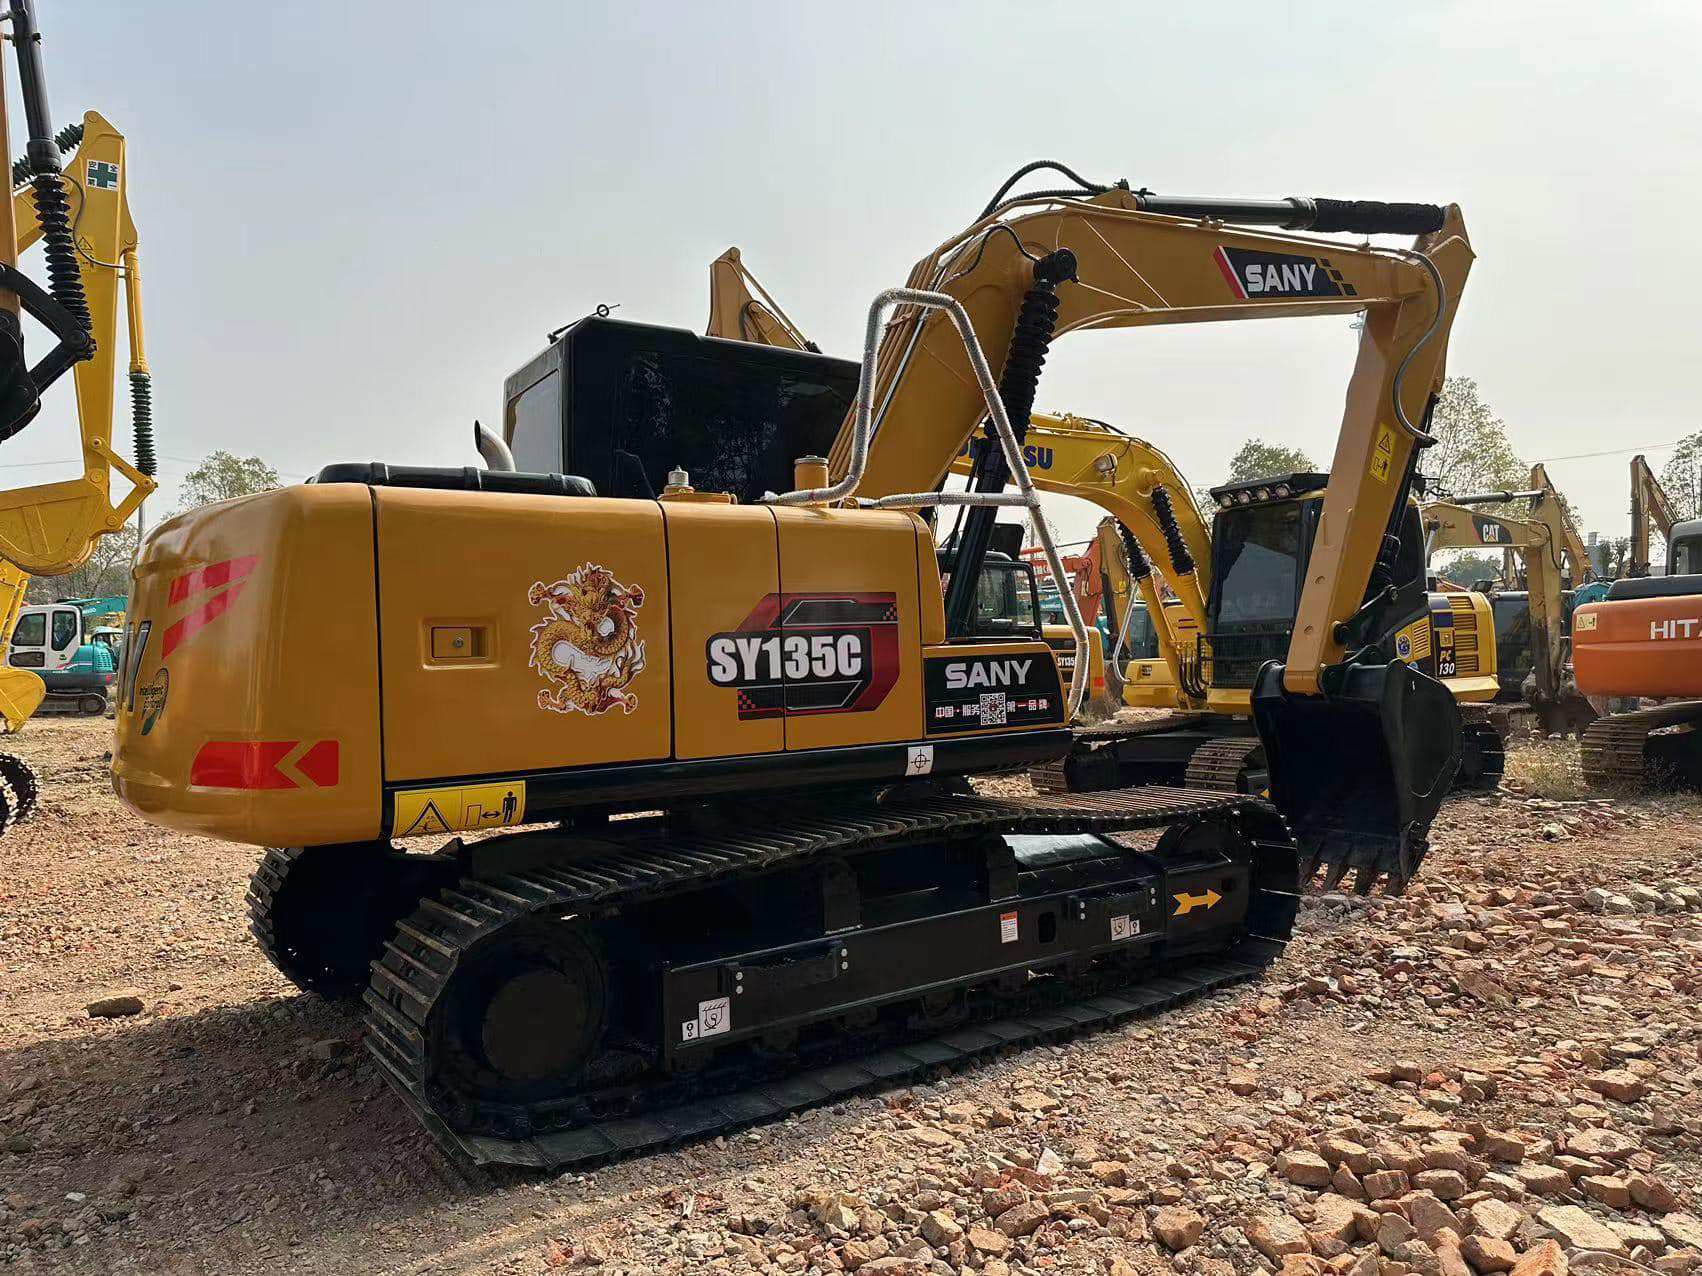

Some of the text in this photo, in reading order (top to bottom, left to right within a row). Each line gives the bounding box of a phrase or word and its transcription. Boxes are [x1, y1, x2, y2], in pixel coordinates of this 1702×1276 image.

[1245, 264, 1316, 292] SANY
[1482, 524, 1500, 543] CAT
[1650, 618, 1702, 641] HIT
[709, 634, 863, 683] SY135C
[1057, 656, 1077, 667] SY135
[1439, 649, 1452, 662] PC
[945, 659, 1033, 689] SANY
[1439, 662, 1455, 675] 130
